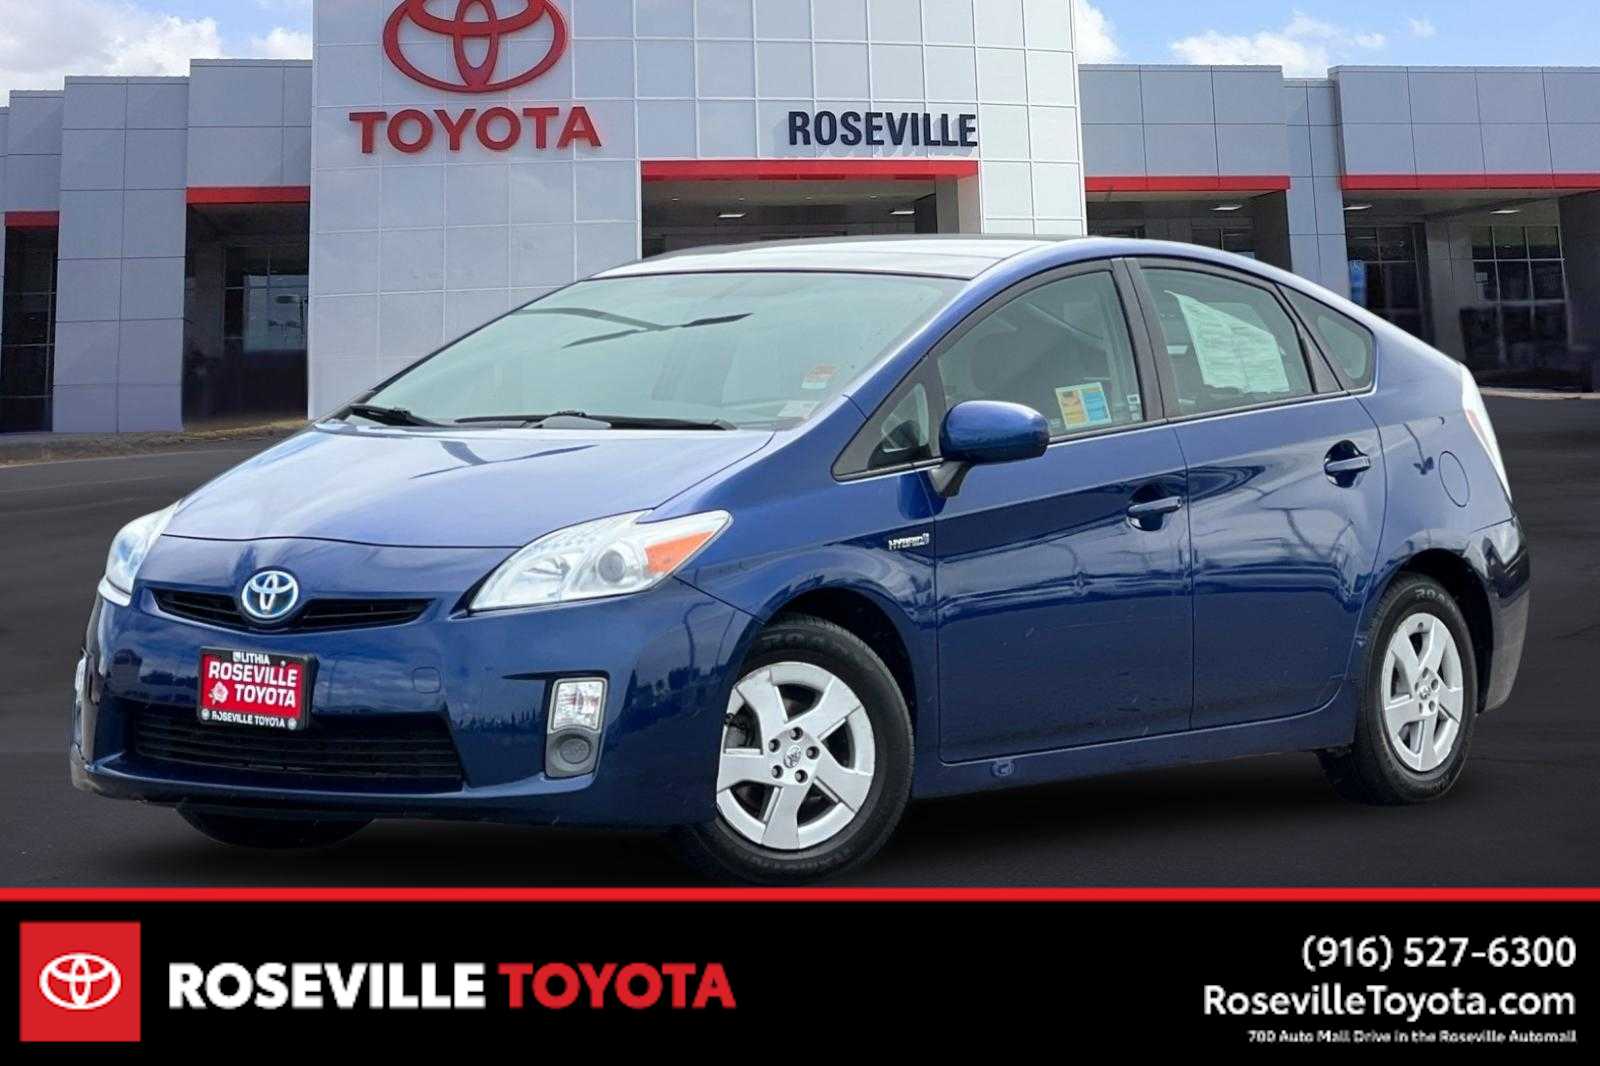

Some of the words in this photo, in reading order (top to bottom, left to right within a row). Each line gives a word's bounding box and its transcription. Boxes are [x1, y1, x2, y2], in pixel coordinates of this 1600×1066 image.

[349, 106, 602, 154] TOYOTA
[788, 111, 978, 147] ROSEVILLE
[242, 652, 270, 665] LITHIA
[208, 661, 298, 687] ROSEVILLE
[234, 684, 296, 708] TOYOTA
[212, 711, 253, 725] ROSEVILLE
[254, 715, 285, 728] TOYOTA
